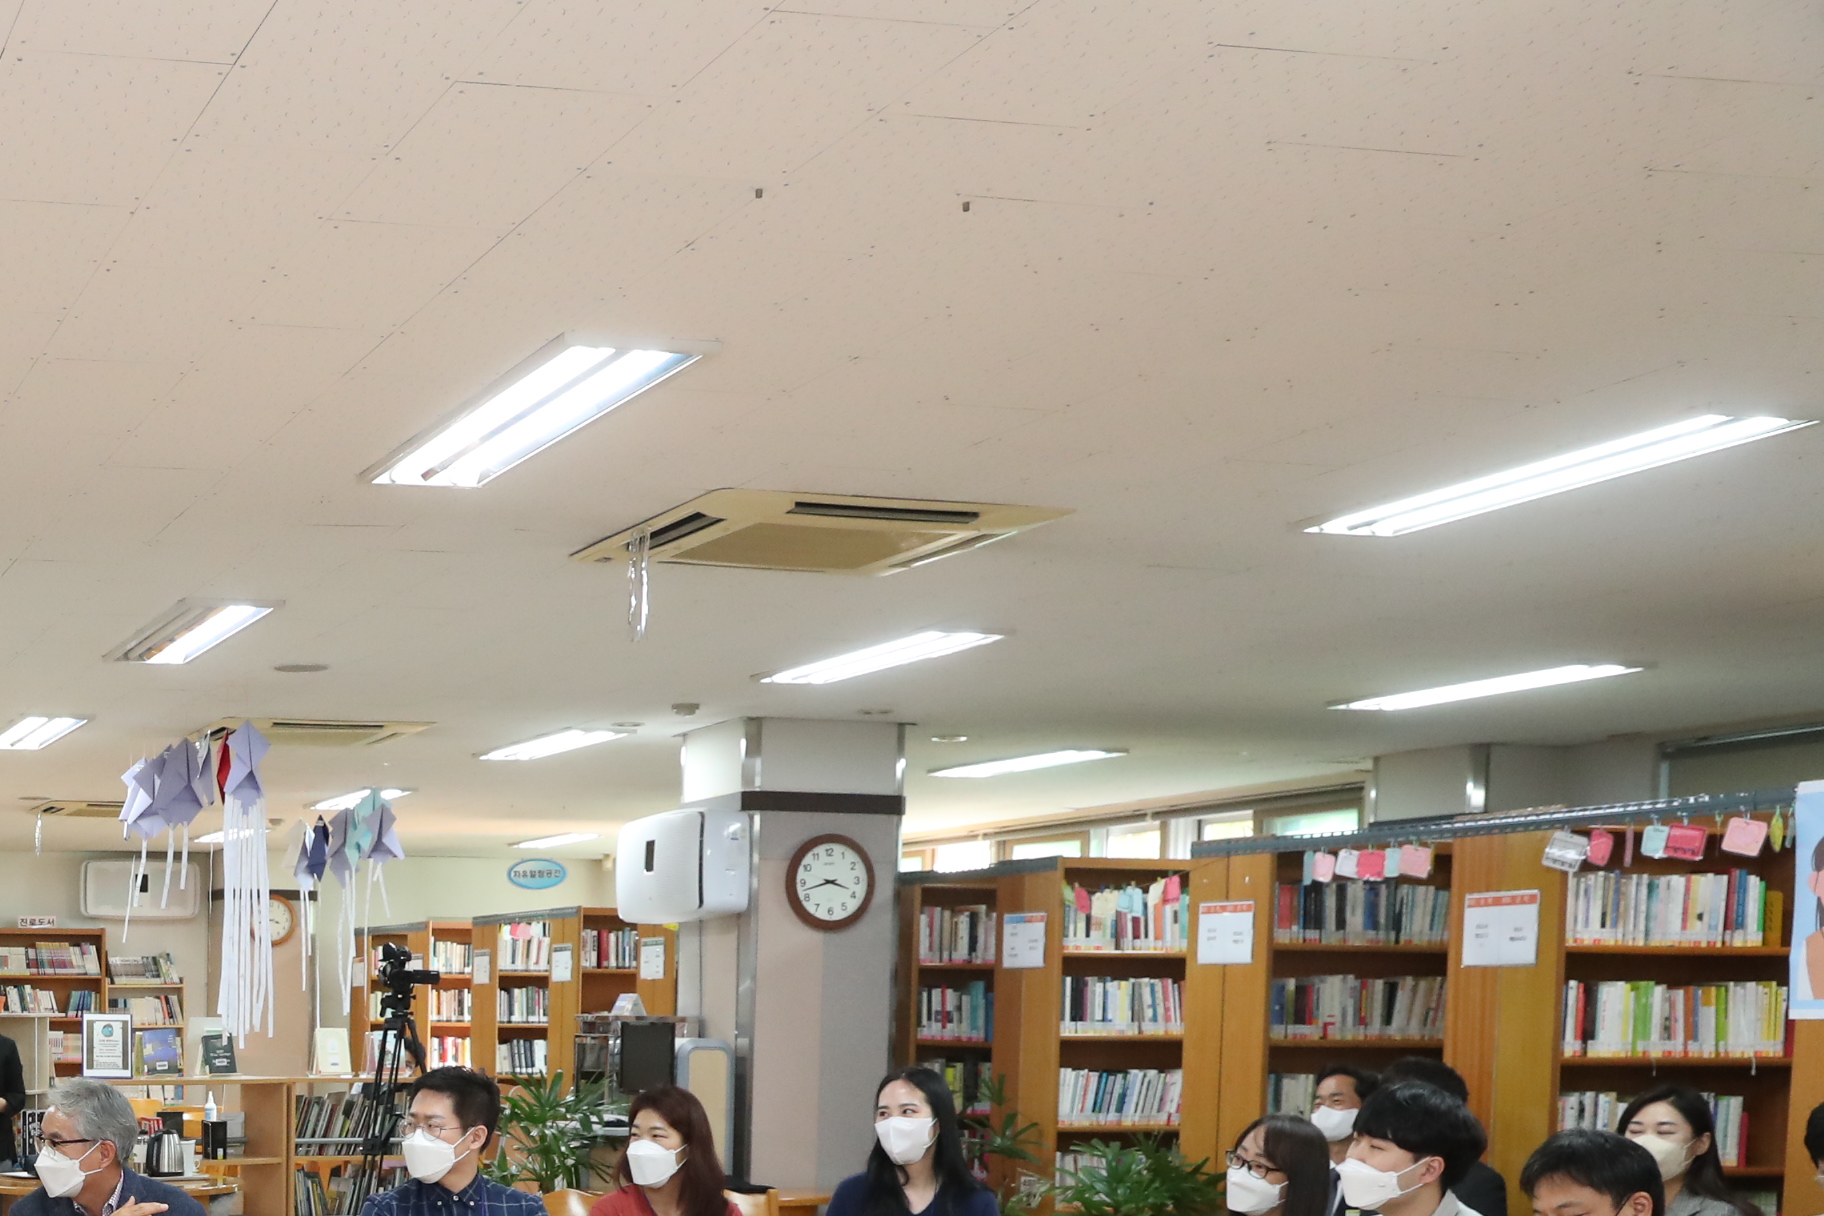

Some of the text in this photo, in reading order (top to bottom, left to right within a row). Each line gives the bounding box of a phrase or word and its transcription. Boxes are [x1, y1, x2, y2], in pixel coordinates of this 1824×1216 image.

[825, 847, 834, 857] 12
[841, 852, 845, 860] 1
[812, 853, 820, 861] 11
[803, 864, 812, 872] 10
[850, 862, 856, 871] 2
[800, 879, 806, 887] 9
[854, 876, 860, 885] 3
[804, 893, 810, 902] 8
[850, 891, 856, 899] 4
[814, 903, 820, 912] 7
[827, 907, 834, 916] 6
[841, 903, 847, 911] 5
[19, 918, 55, 927] 진로도서
